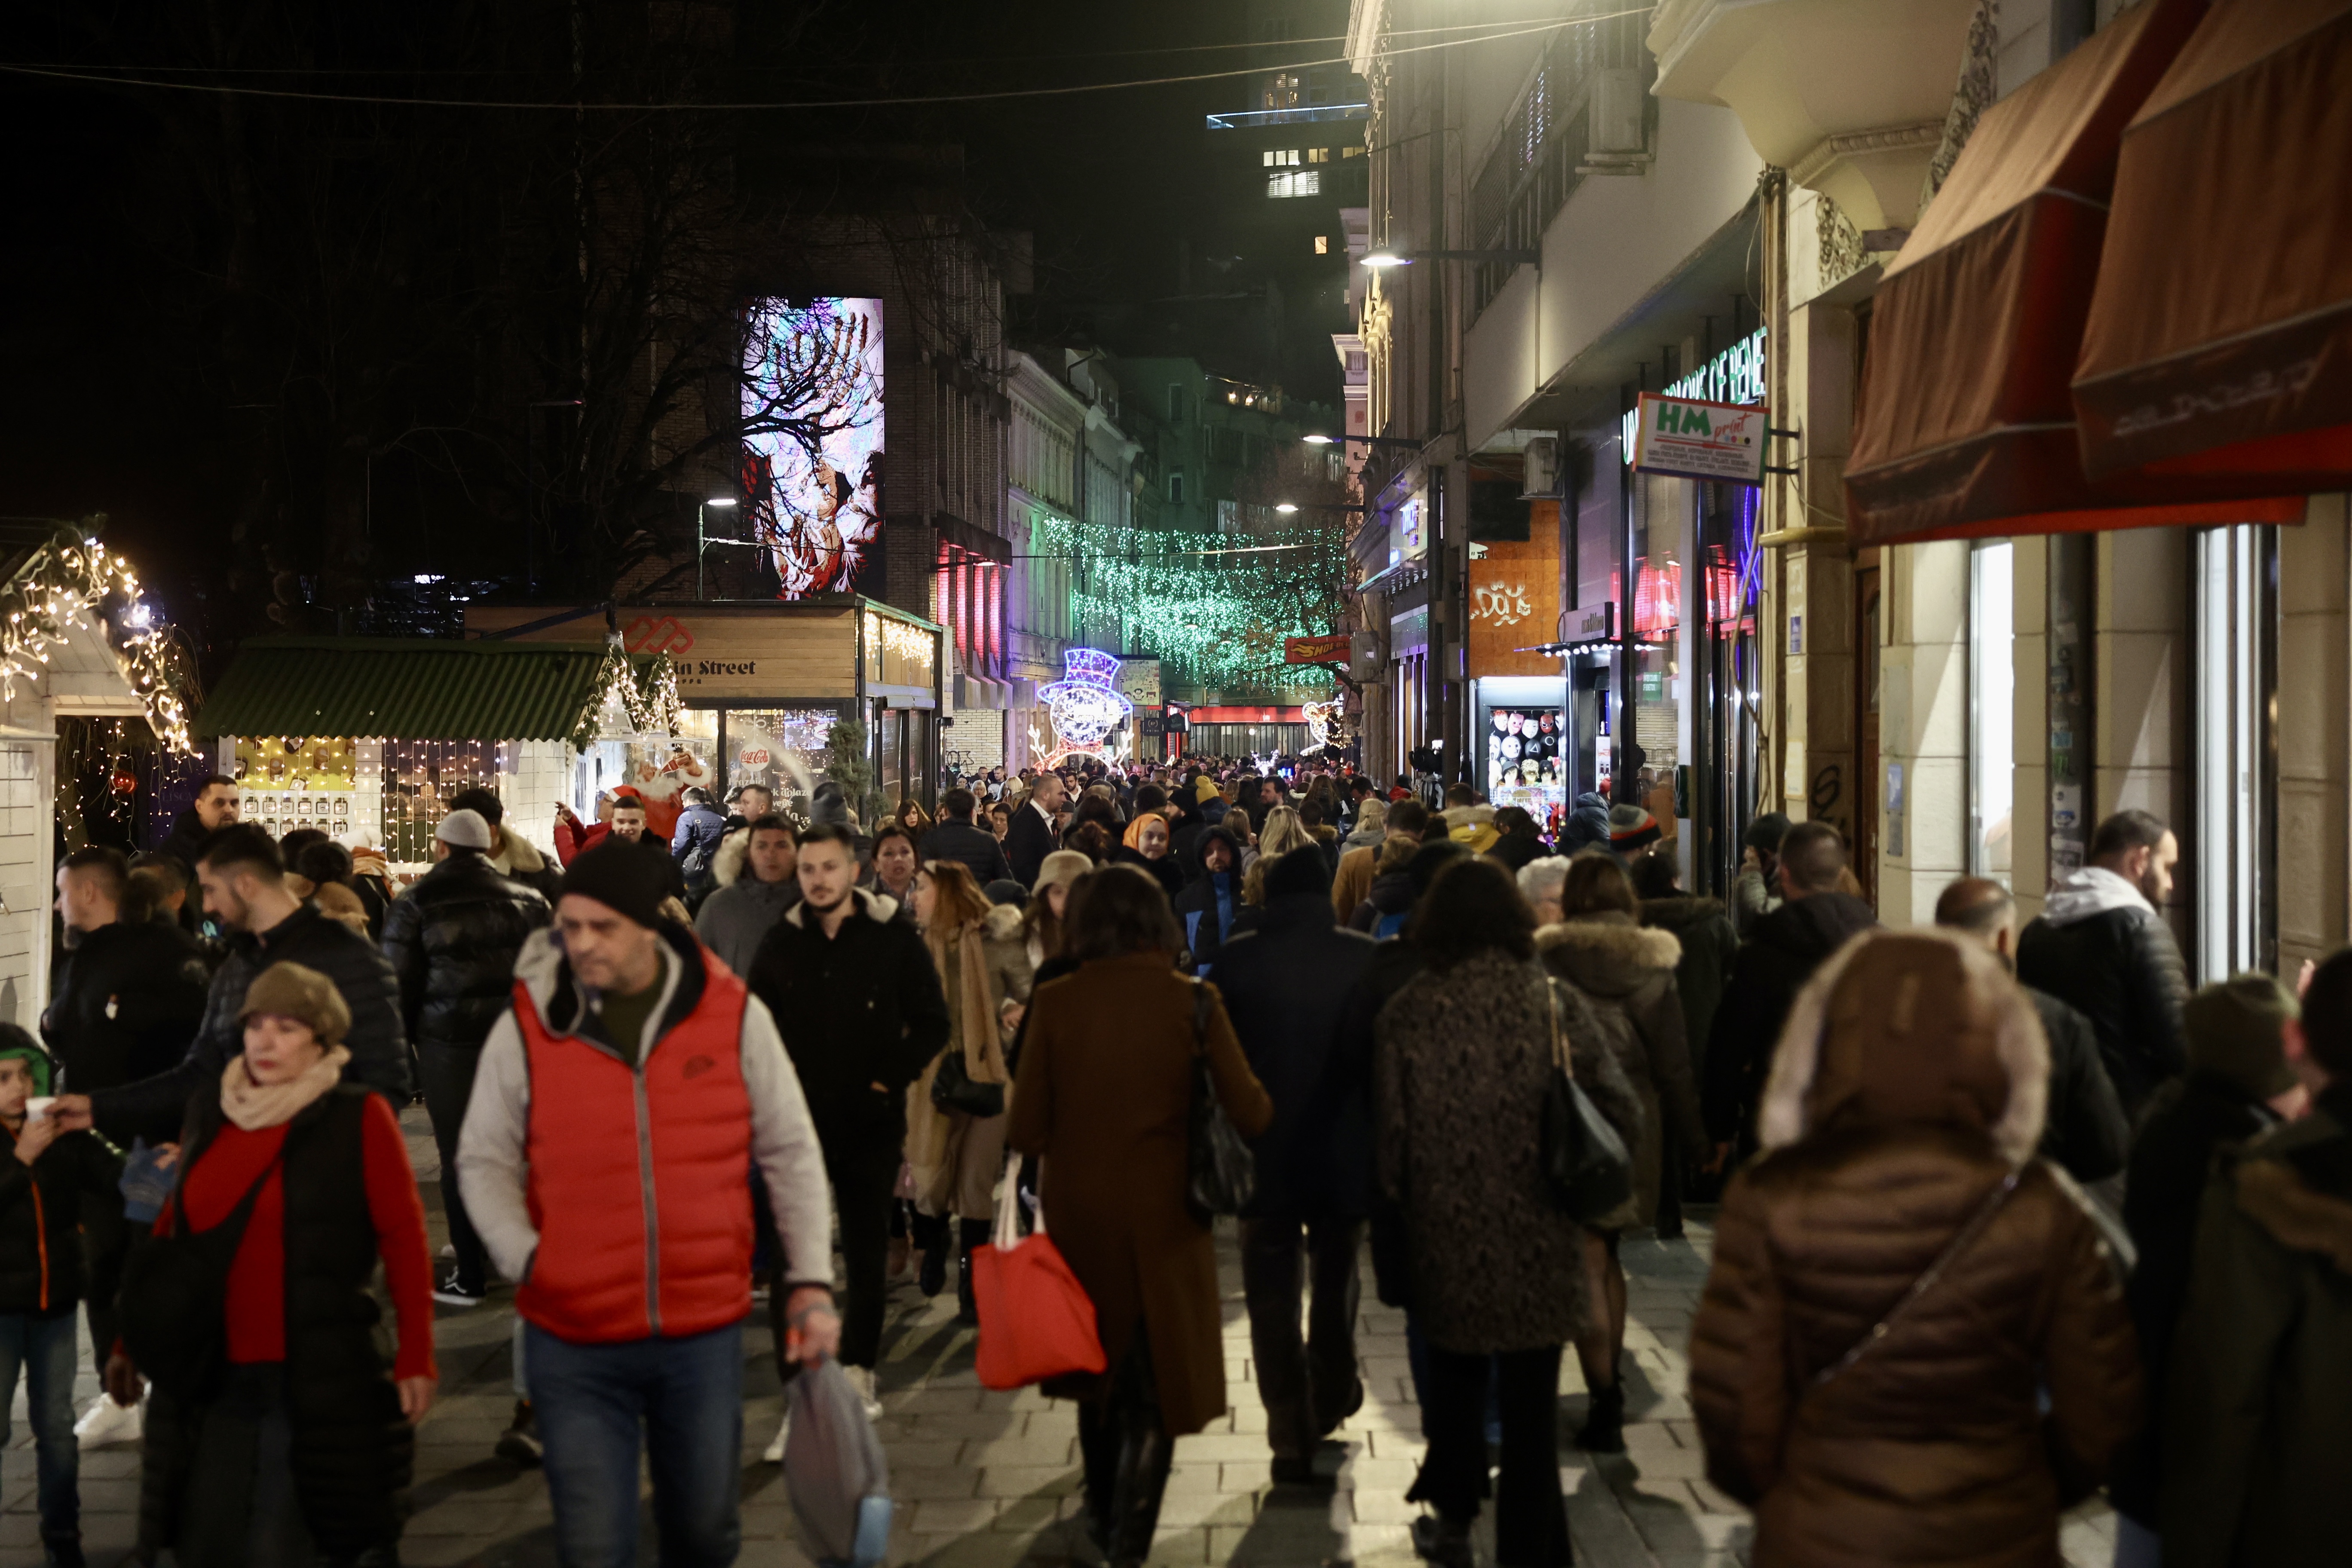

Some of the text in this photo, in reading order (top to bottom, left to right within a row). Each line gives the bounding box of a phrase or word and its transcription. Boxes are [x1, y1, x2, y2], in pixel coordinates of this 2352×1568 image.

[1709, 350, 1727, 403] OF
[1729, 326, 1767, 405] BENE
[1657, 401, 1754, 443] HM print
[699, 660, 756, 675] Street
[741, 749, 768, 764] Coca-Cola
[781, 787, 812, 796] dolaze
